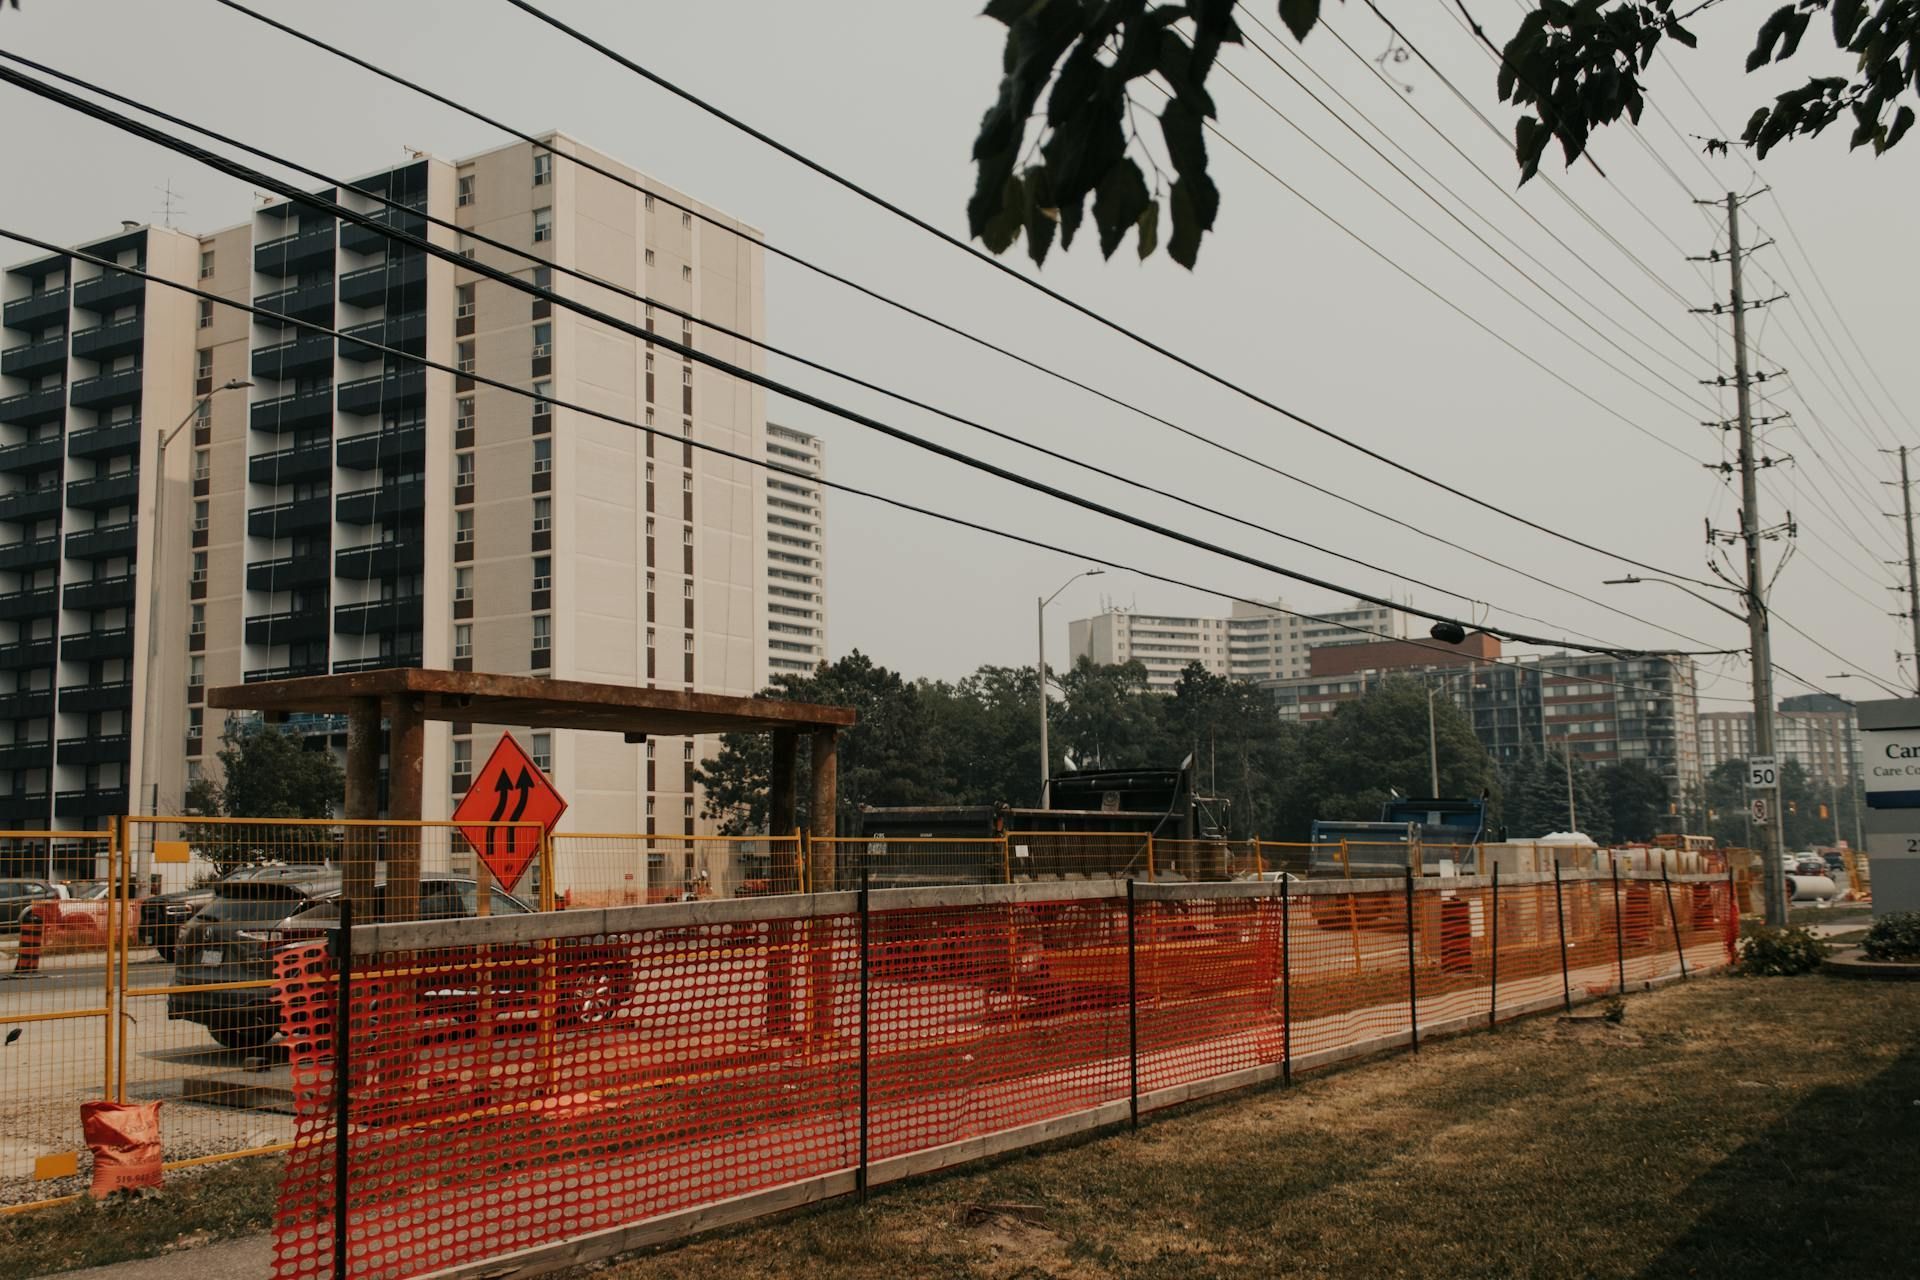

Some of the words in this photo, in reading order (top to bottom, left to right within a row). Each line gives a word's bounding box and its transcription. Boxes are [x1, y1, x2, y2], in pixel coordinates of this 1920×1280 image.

[1753, 769, 1775, 784] 50
[1873, 766, 1903, 777] Care
[1907, 838, 1920, 853] 2
